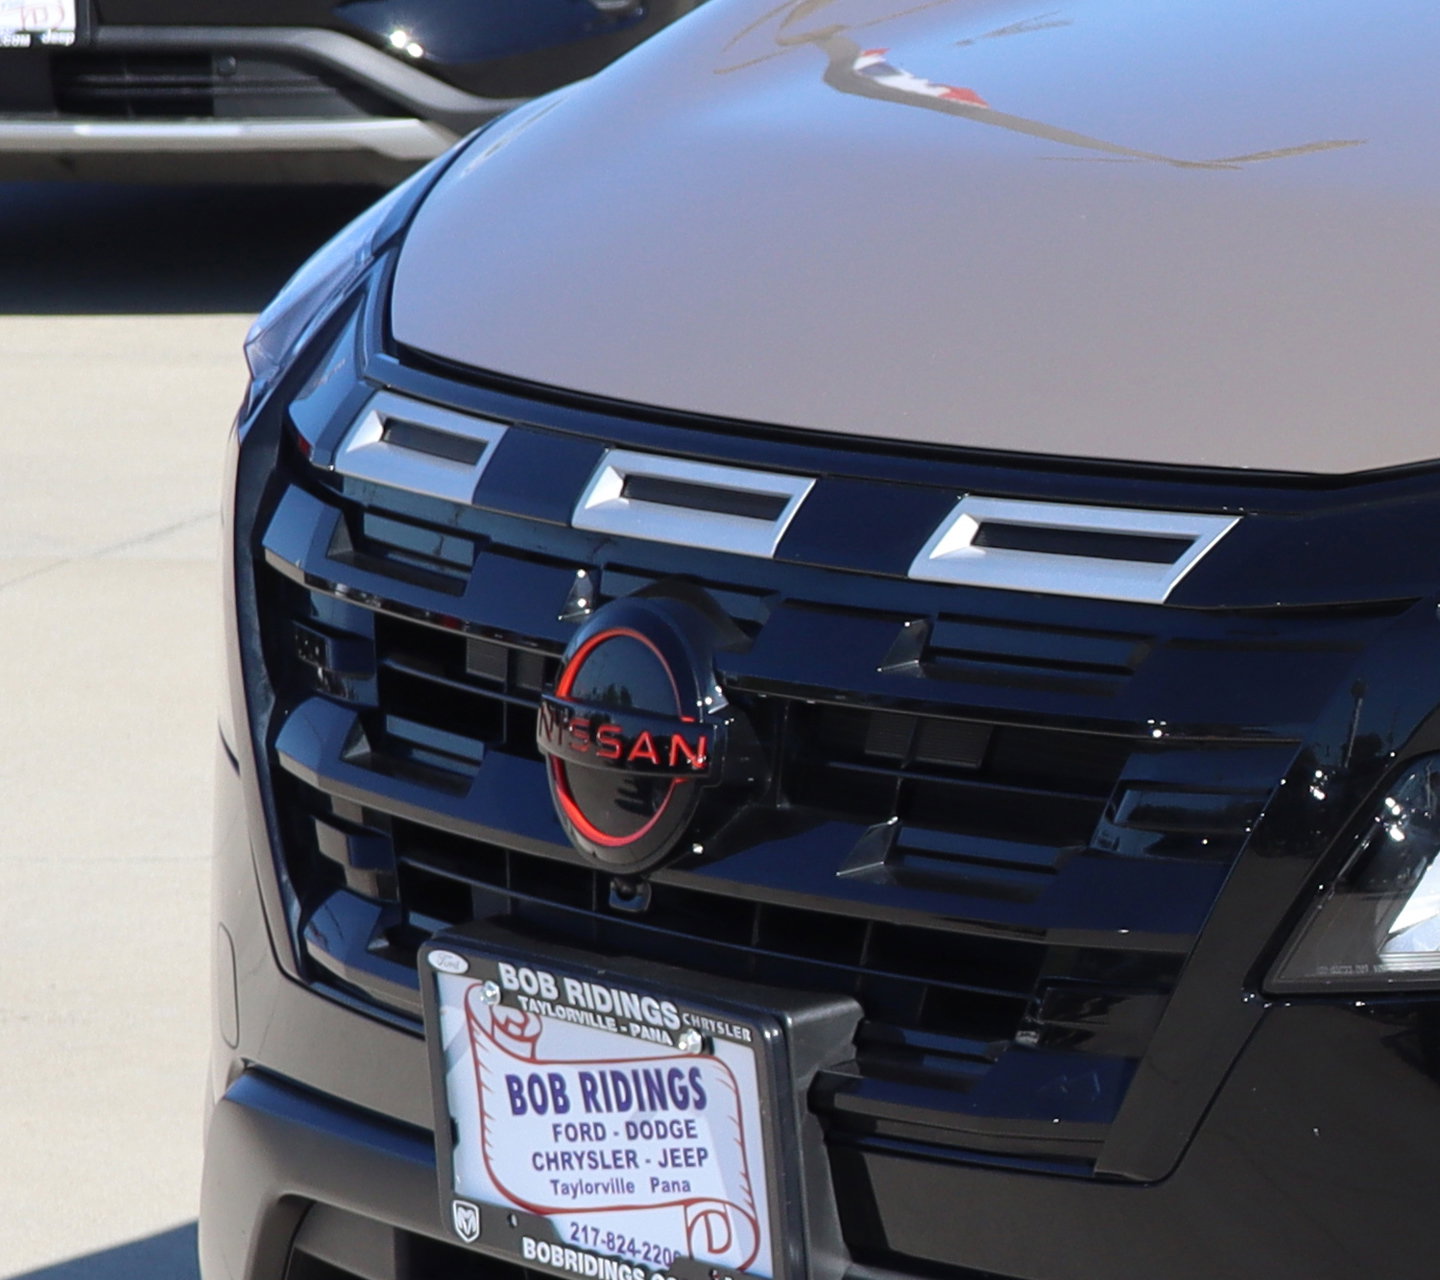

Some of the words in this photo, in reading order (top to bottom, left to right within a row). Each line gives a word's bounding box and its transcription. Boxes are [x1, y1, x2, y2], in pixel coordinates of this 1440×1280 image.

[539, 703, 708, 769] NISSAN
[498, 962, 559, 1001] BOB
[563, 977, 682, 1031] RIDINGS
[517, 994, 619, 1033] TAYLORVILLE
[630, 1027, 674, 1047] PANA
[682, 1012, 752, 1043] CHRYSLER
[505, 1072, 571, 1117] BOB
[578, 1066, 708, 1114] RIDINGS
[552, 1122, 607, 1143] FORD
[625, 1119, 699, 1141] DODGE
[531, 1148, 640, 1172] CHRYSLER
[657, 1147, 709, 1169] JEEP
[549, 1178, 636, 1200] Taylorville
[649, 1176, 692, 1193] Pana
